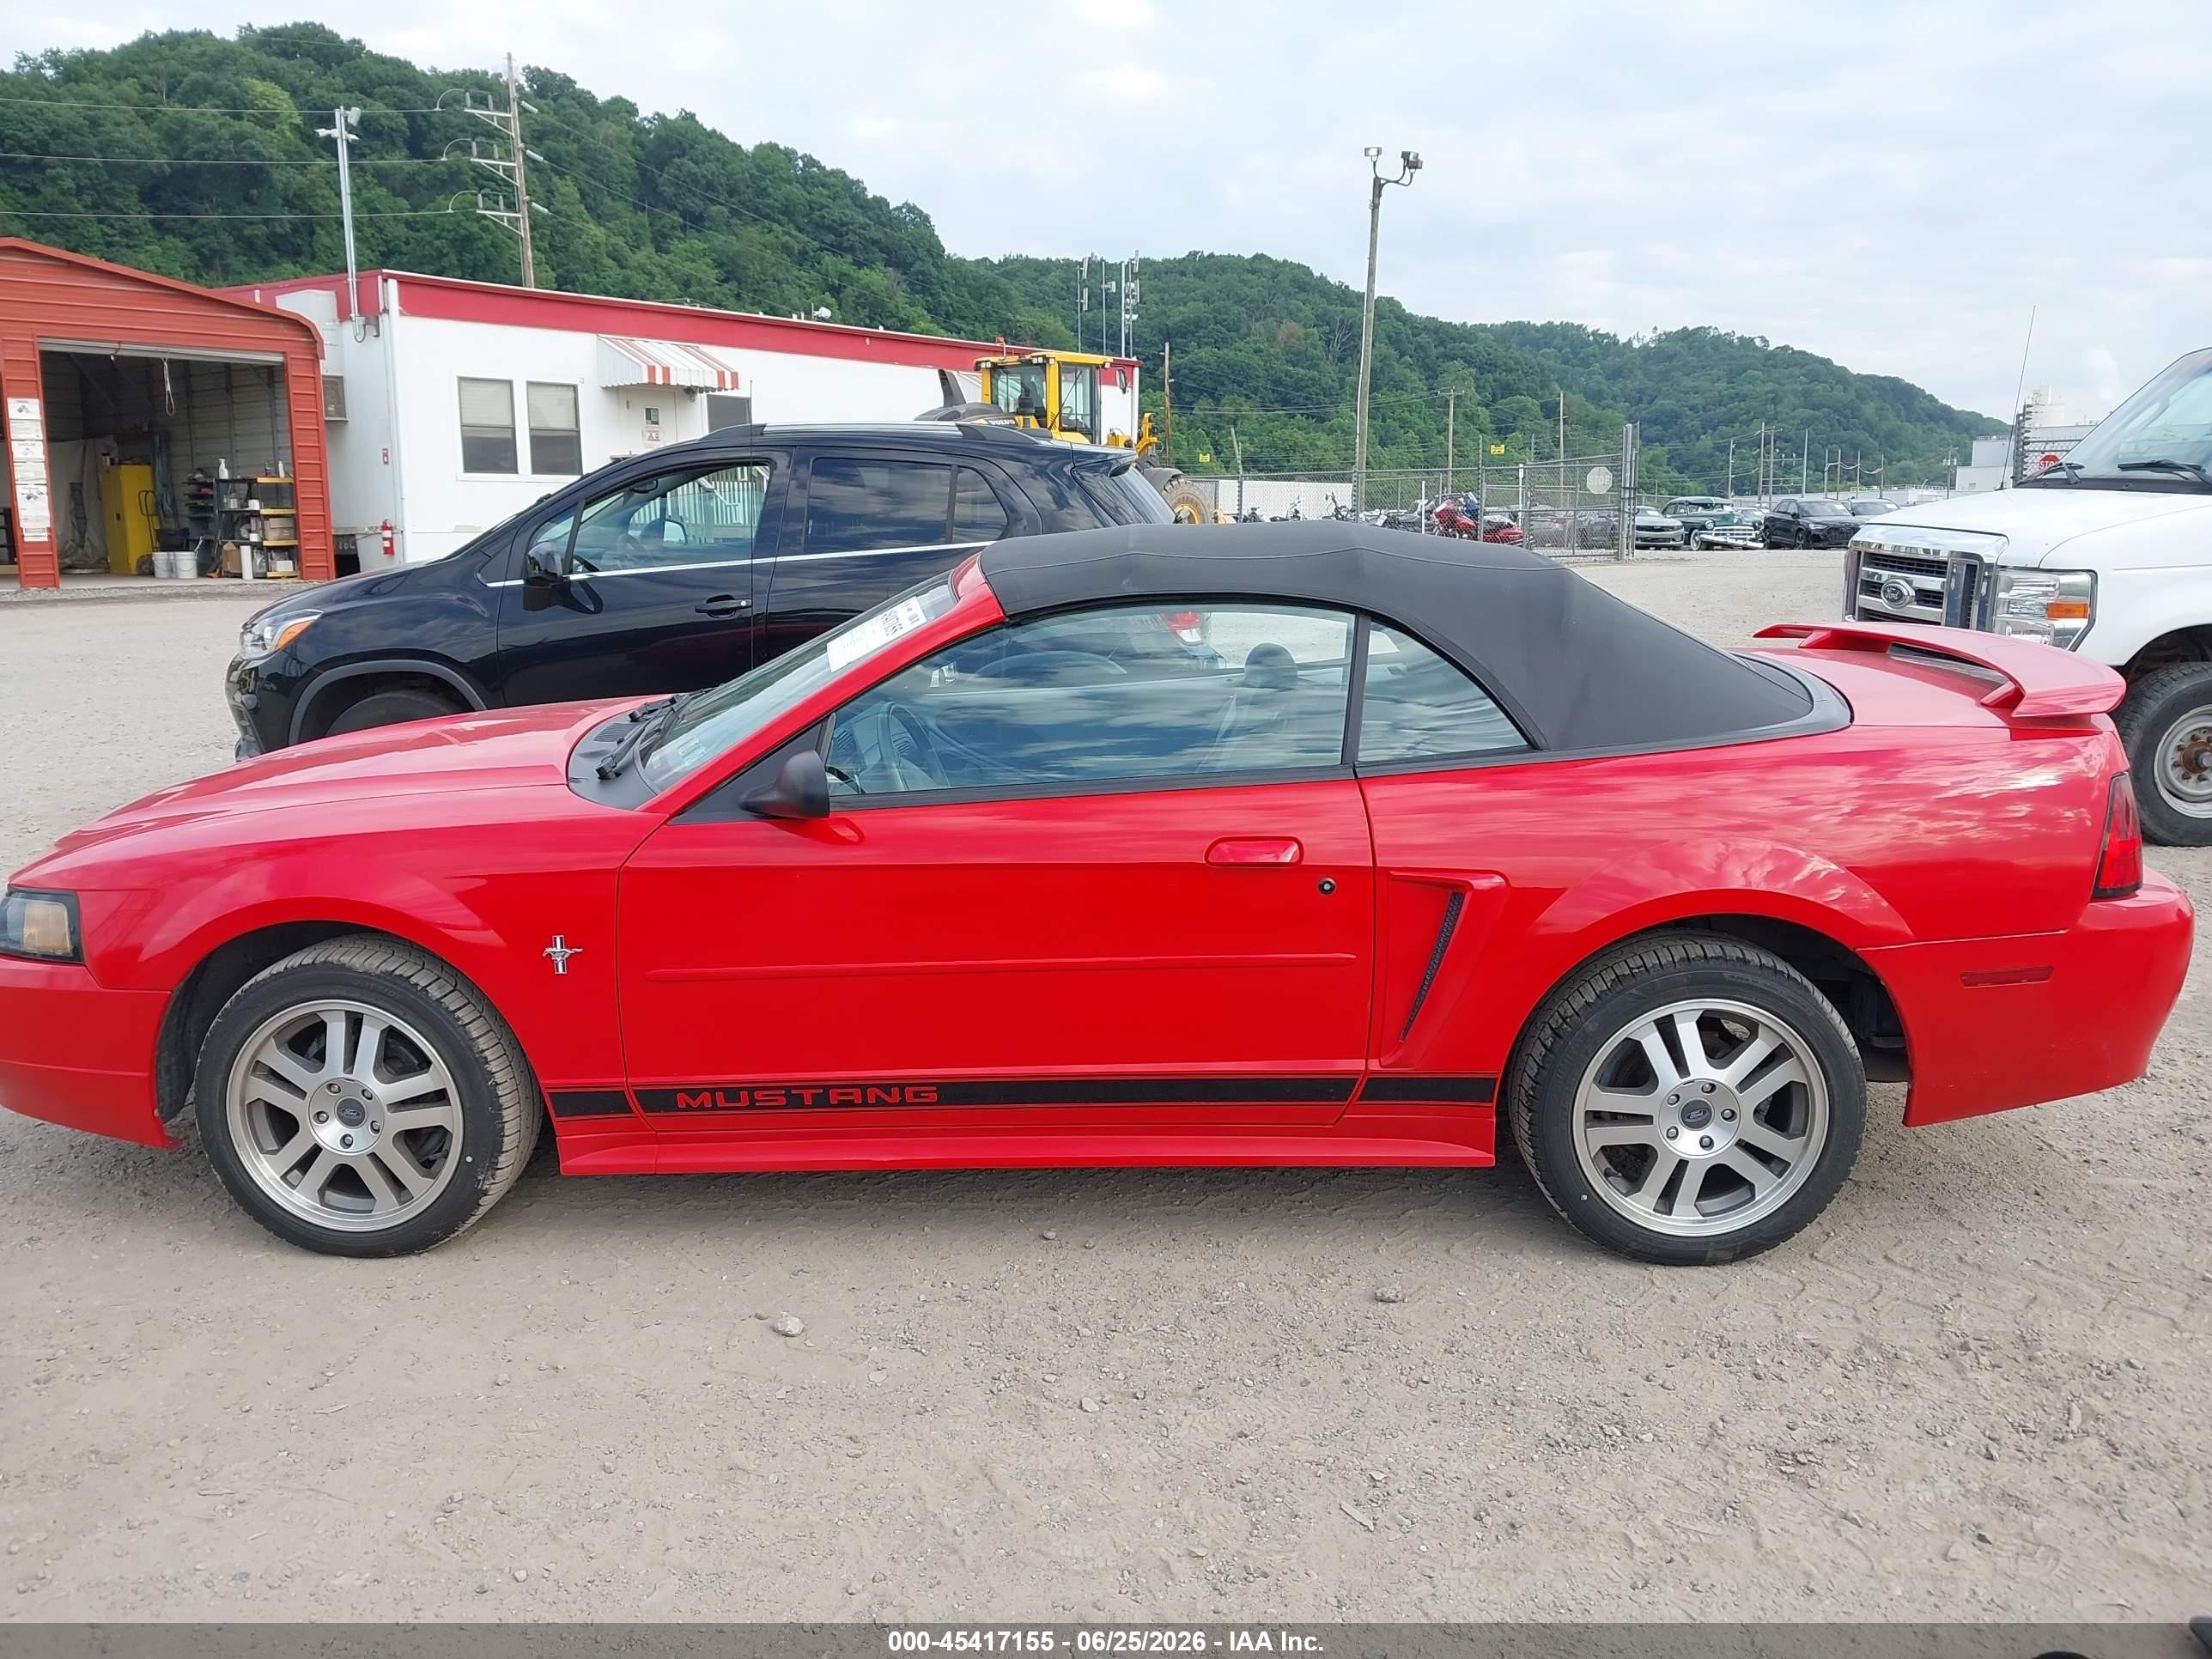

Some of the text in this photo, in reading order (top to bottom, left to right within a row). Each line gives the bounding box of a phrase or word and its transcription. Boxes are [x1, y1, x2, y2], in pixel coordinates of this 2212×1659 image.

[2039, 460, 2057, 469] STO
[1589, 474, 1611, 485] STOP
[677, 1086, 938, 1108] MUSTANG
